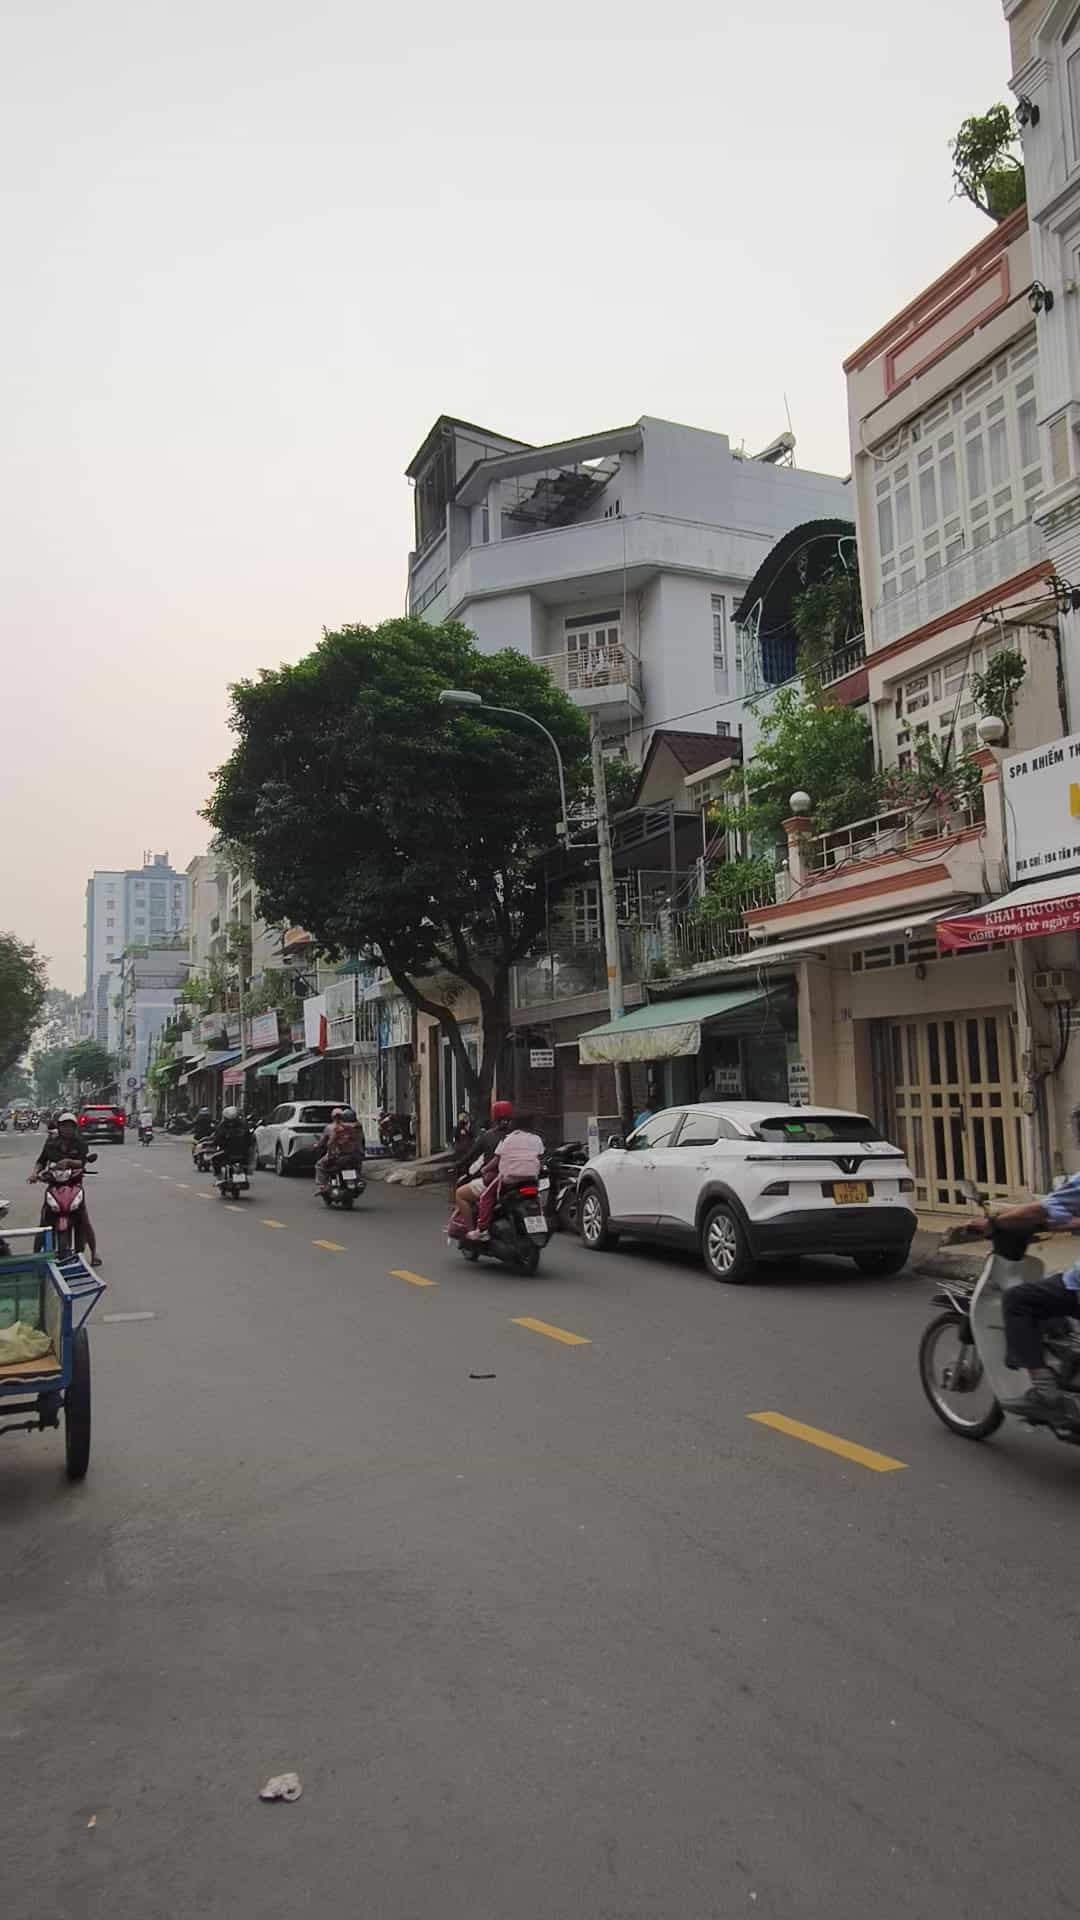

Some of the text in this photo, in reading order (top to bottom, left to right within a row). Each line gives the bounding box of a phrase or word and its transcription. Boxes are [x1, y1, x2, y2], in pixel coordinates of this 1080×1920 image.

[1009, 763, 1028, 778] SPA
[985, 908, 1015, 925] KHAI
[998, 924, 1022, 936] 20%
[1025, 920, 1040, 931] từ
[1042, 914, 1070, 932] ngày
